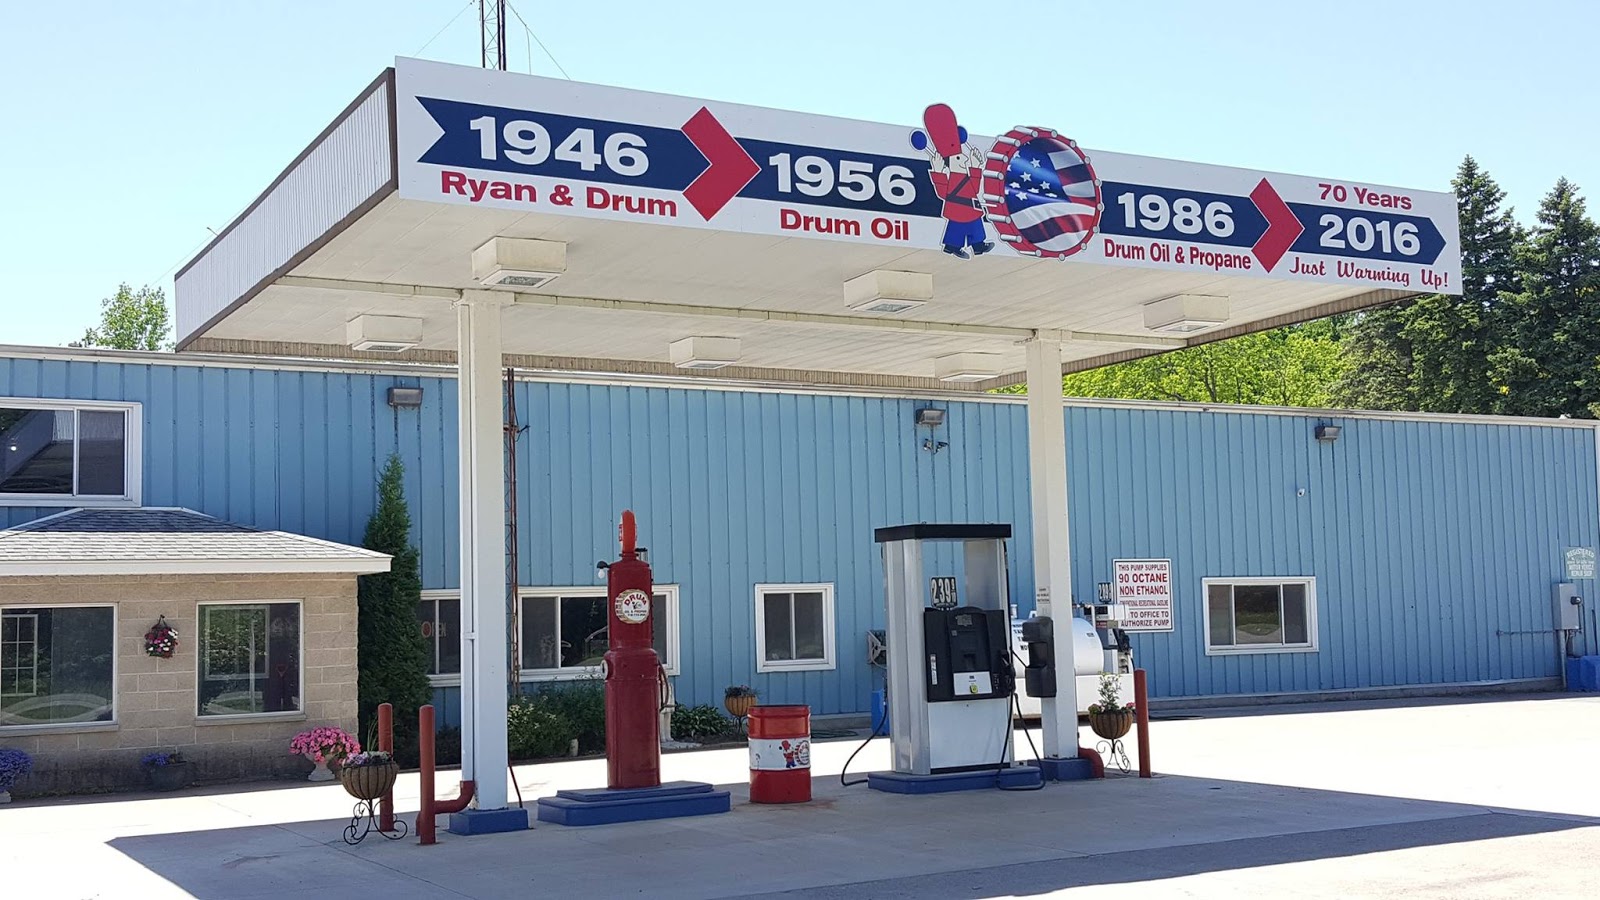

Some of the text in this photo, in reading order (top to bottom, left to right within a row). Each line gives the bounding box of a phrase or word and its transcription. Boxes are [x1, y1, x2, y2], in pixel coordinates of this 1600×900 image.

[469, 115, 650, 177] 1946
[441, 170, 677, 217] Ryan & Drum
[768, 152, 916, 206] 1956
[1318, 183, 1412, 210] 70 Years
[780, 208, 910, 241] Drum Oil
[1117, 192, 1235, 238] 1986
[1319, 214, 1421, 256] 2016
[1104, 238, 1252, 271] Drum Oil & Propane
[1289, 257, 1449, 288] Just Warming Up!
[1118, 573, 1168, 583] 90 OCTANE
[1119, 585, 1168, 595] NON ETHANOL
[624, 594, 647, 606] DRUM
[1130, 611, 1139, 619] TO
